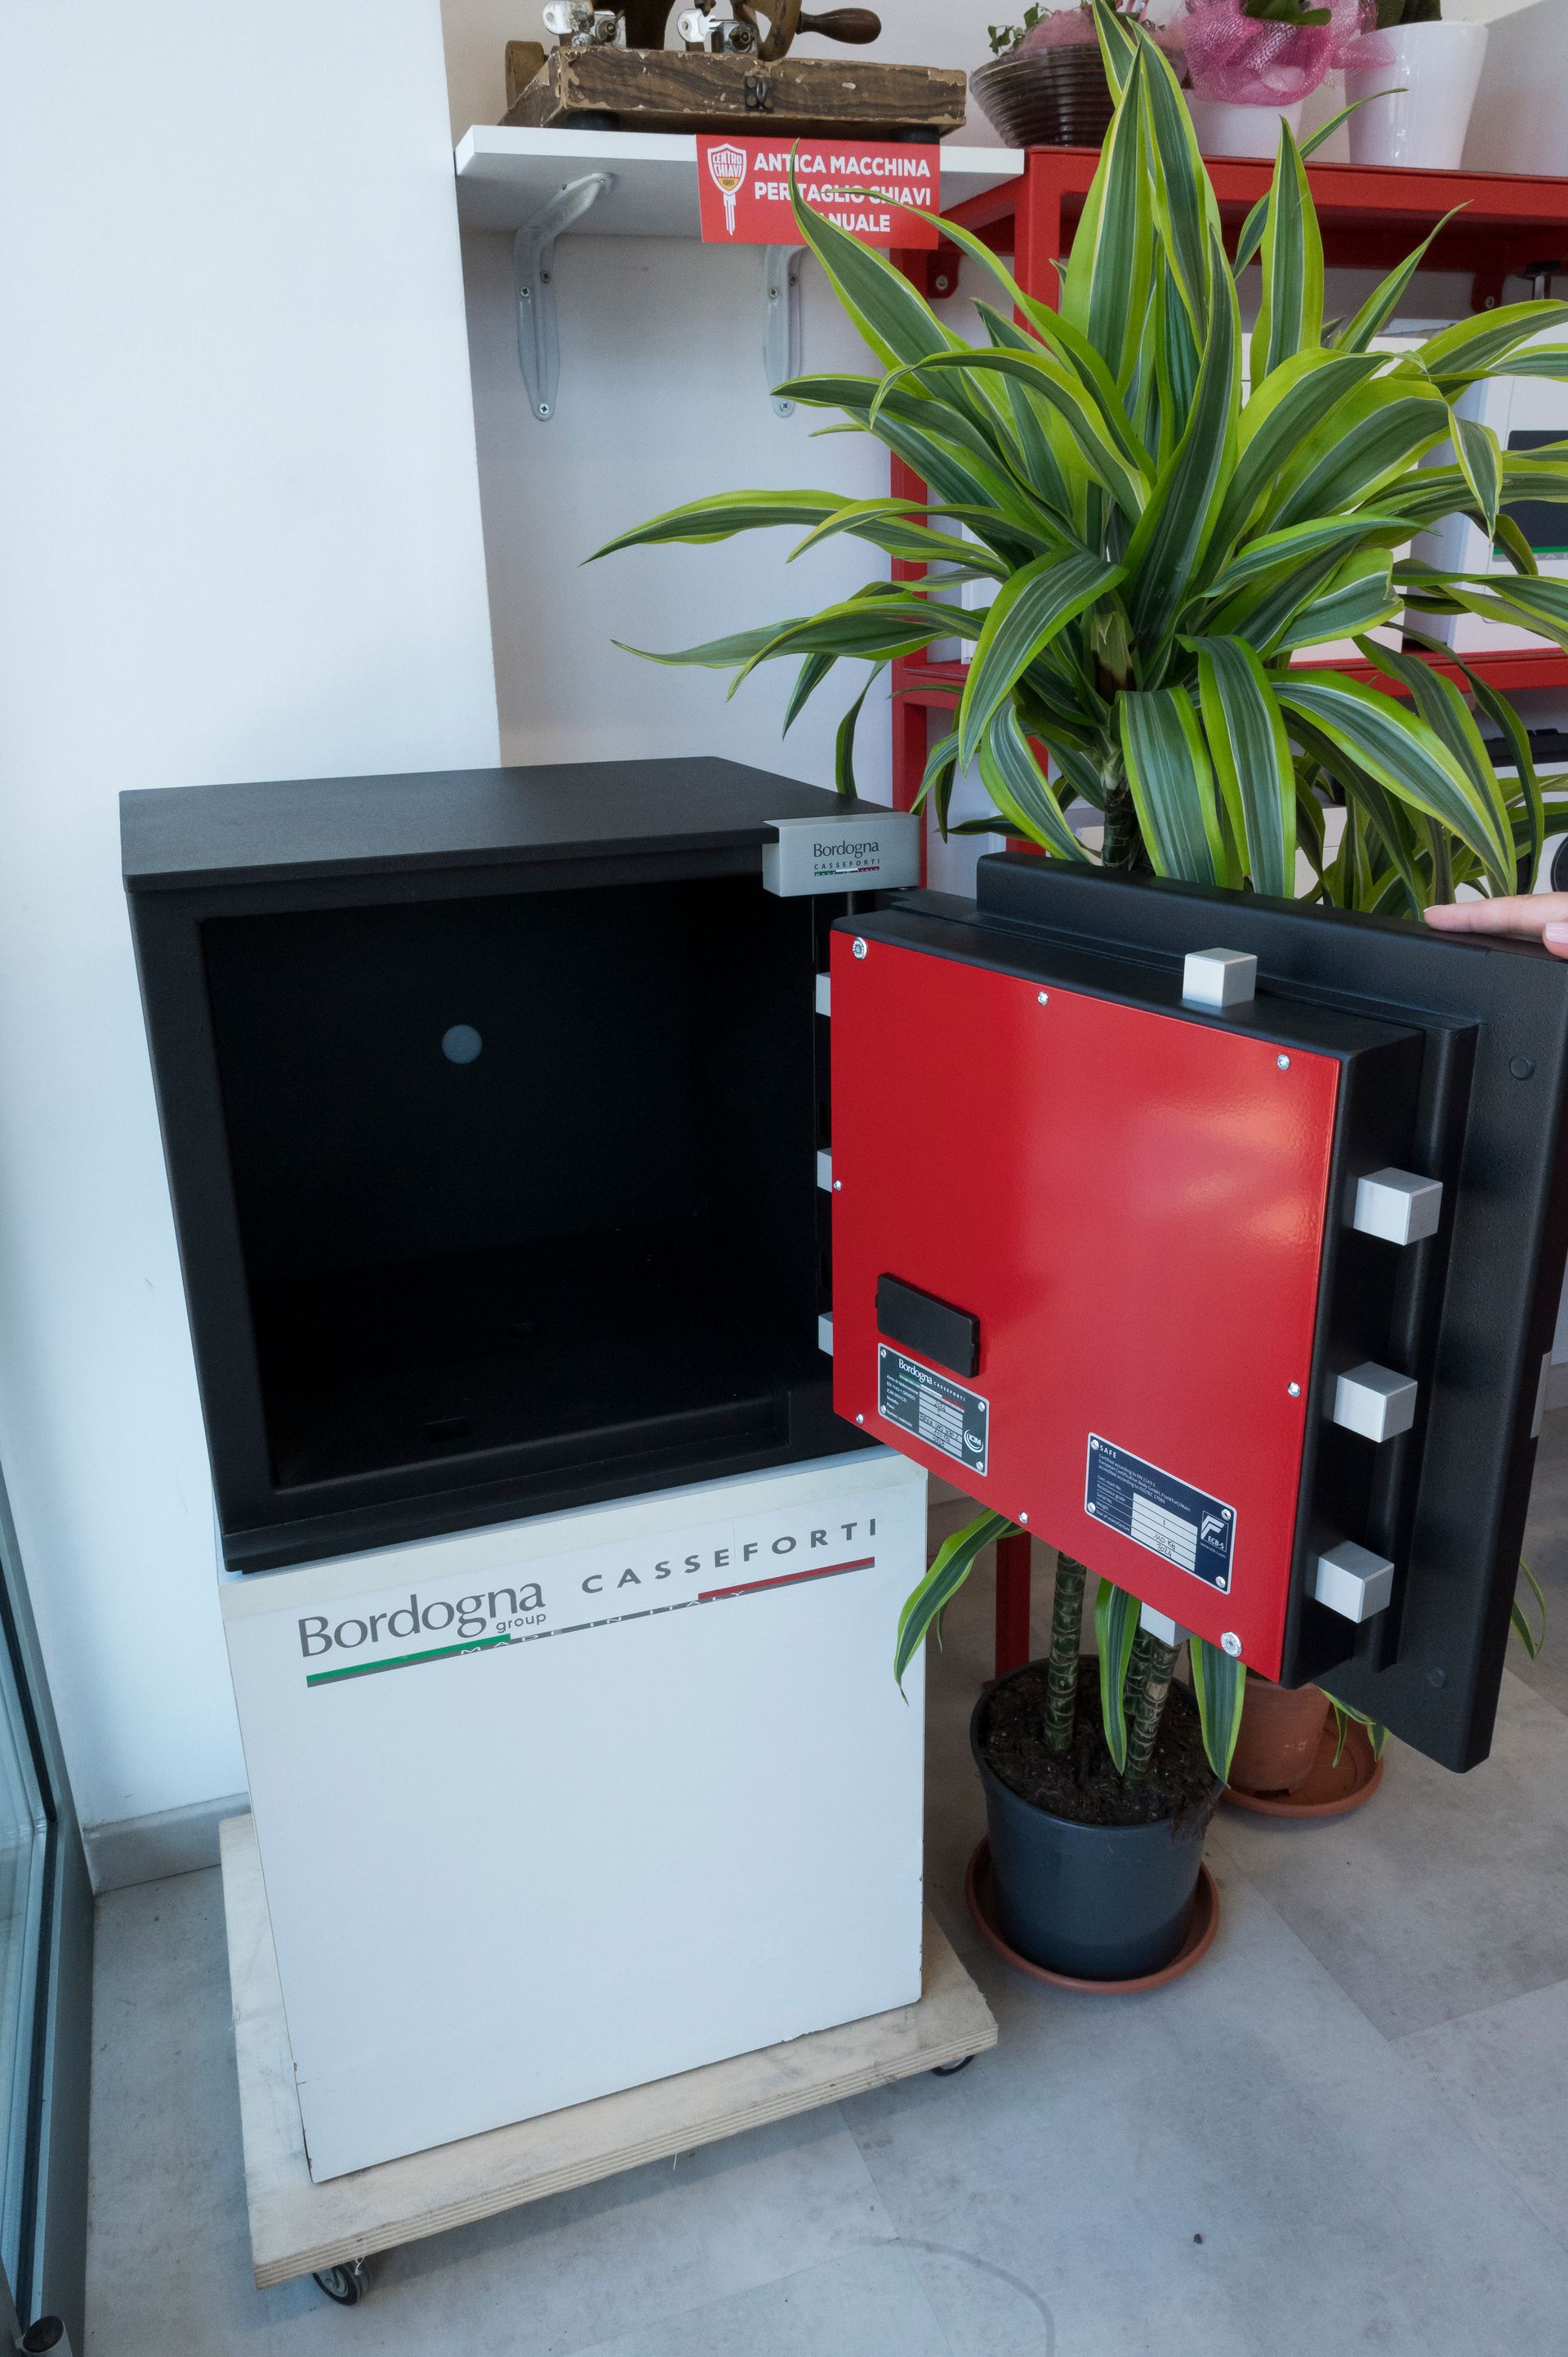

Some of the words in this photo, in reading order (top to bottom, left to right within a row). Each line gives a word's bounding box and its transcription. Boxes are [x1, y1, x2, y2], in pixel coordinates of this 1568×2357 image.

[711, 150, 742, 164] CENTRO
[754, 153, 826, 173] ANTICA
[830, 156, 931, 177] MACCHINA
[713, 163, 742, 177] CHIAVI
[755, 181, 791, 201] PER
[797, 184, 864, 203] TAGLIO
[869, 186, 930, 206] CHIAVI
[819, 212, 891, 232] NUALE
[813, 840, 880, 858] Bordogna
[813, 858, 880, 870] CASSEFORTI
[898, 1358, 933, 1385] Bordogna
[1099, 1444, 1117, 1459] SAFE
[1098, 1459, 1116, 1472] European
[1116, 1468, 1138, 1484] Certification
[1138, 1480, 1147, 1490] Body
[1099, 1453, 1115, 1465] Certified
[1115, 1462, 1132, 1476] according
[1098, 1464, 1116, 1477] accredited
[1117, 1474, 1134, 1488] according
[1098, 1484, 1115, 1496] Resistance
[1116, 1494, 1125, 1504] grade
[1156, 1543, 1172, 1558] 2024
[298, 1583, 546, 1658] Bordogna
[581, 1517, 877, 1594] CASSEFORTI
[461, 1629, 563, 1655] MADE
[589, 1616, 623, 1628] IN
[648, 1589, 746, 1615] ITALY
[496, 1612, 546, 1633] group
